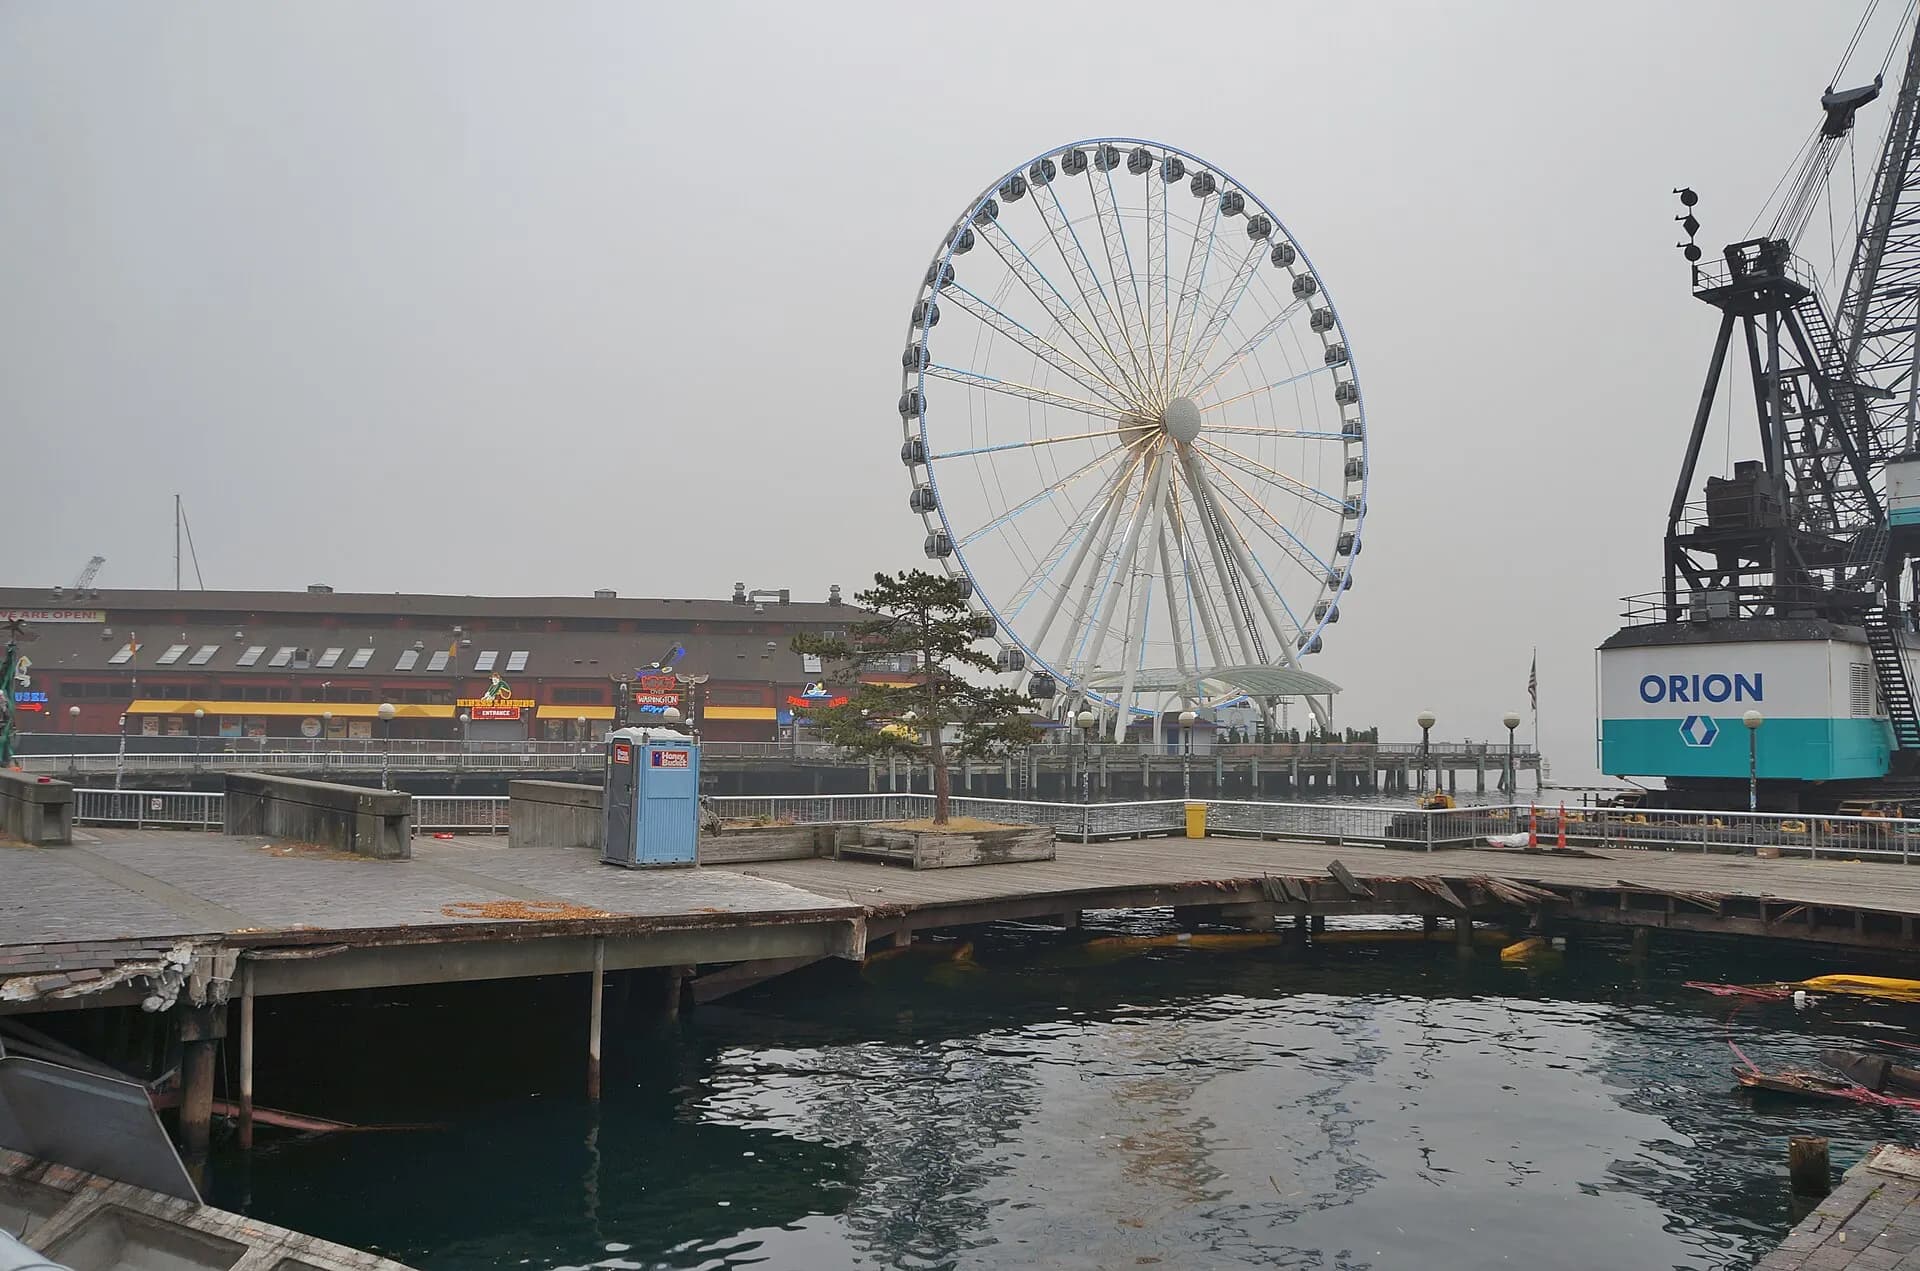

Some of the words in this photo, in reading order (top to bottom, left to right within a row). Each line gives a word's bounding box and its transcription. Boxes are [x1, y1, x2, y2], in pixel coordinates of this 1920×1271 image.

[21, 611, 48, 619] ARE
[53, 611, 96, 619] OPEN!
[1640, 673, 1763, 703] ORION
[662, 751, 685, 760] Honey
